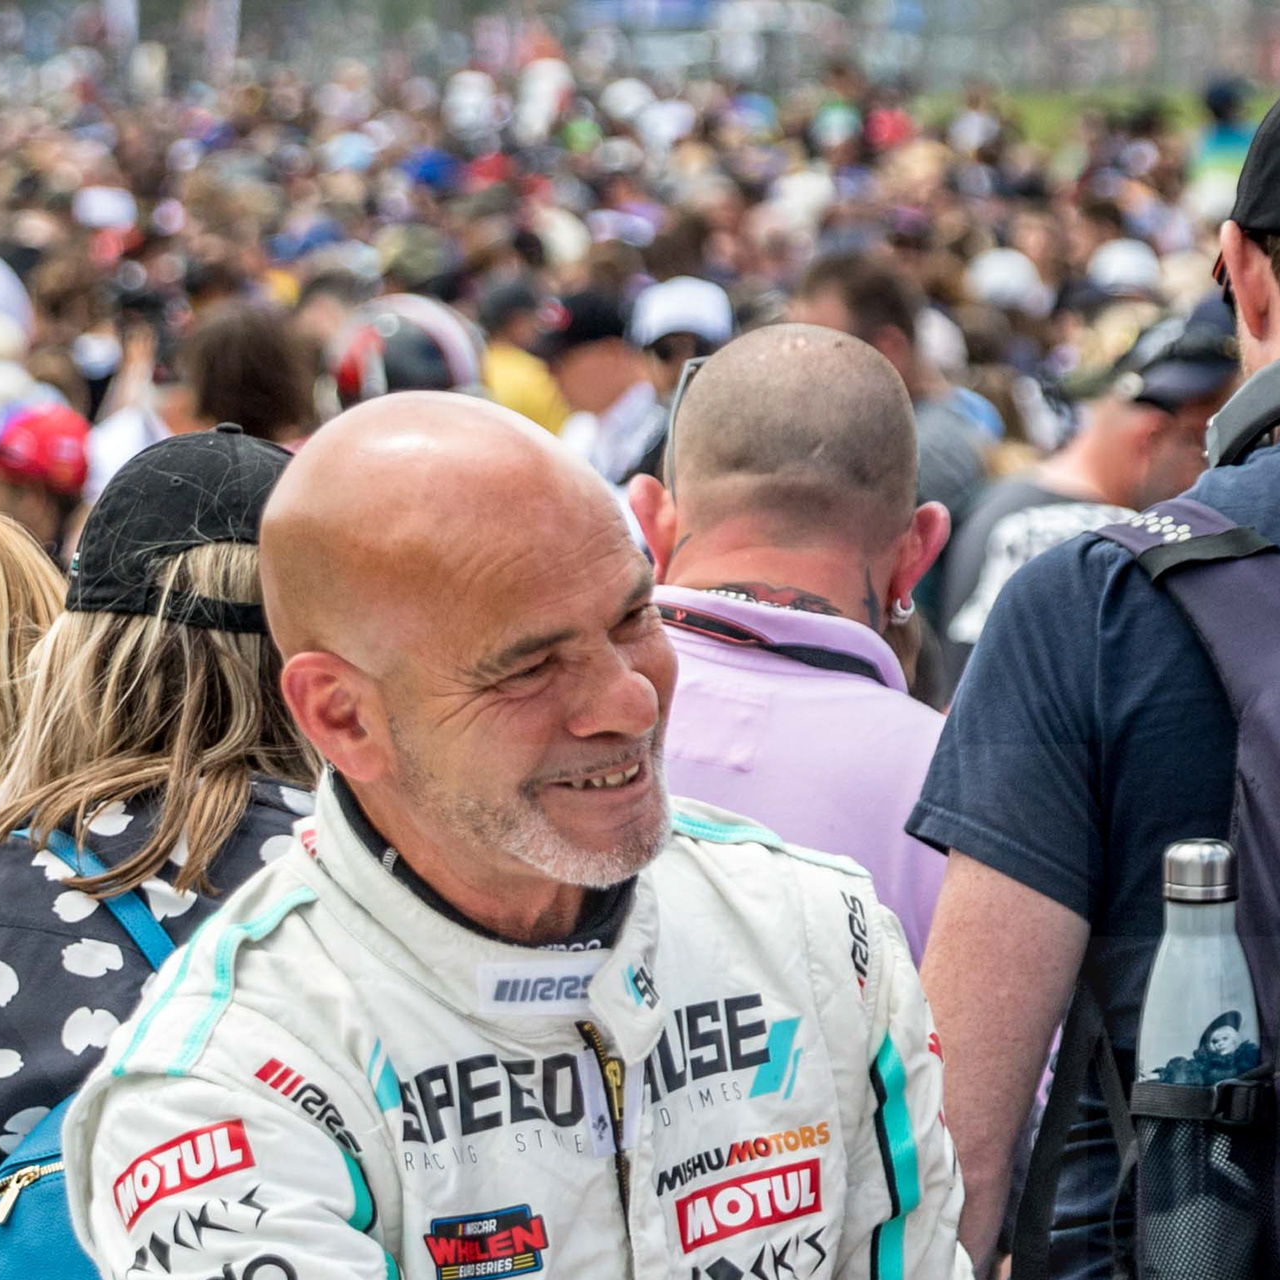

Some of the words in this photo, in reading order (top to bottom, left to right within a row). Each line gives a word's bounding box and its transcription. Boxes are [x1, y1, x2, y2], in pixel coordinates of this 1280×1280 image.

[117, 1126, 244, 1227] MOTUL
[685, 1167, 817, 1245] MOTUL
[475, 1257, 513, 1276] SERIES
